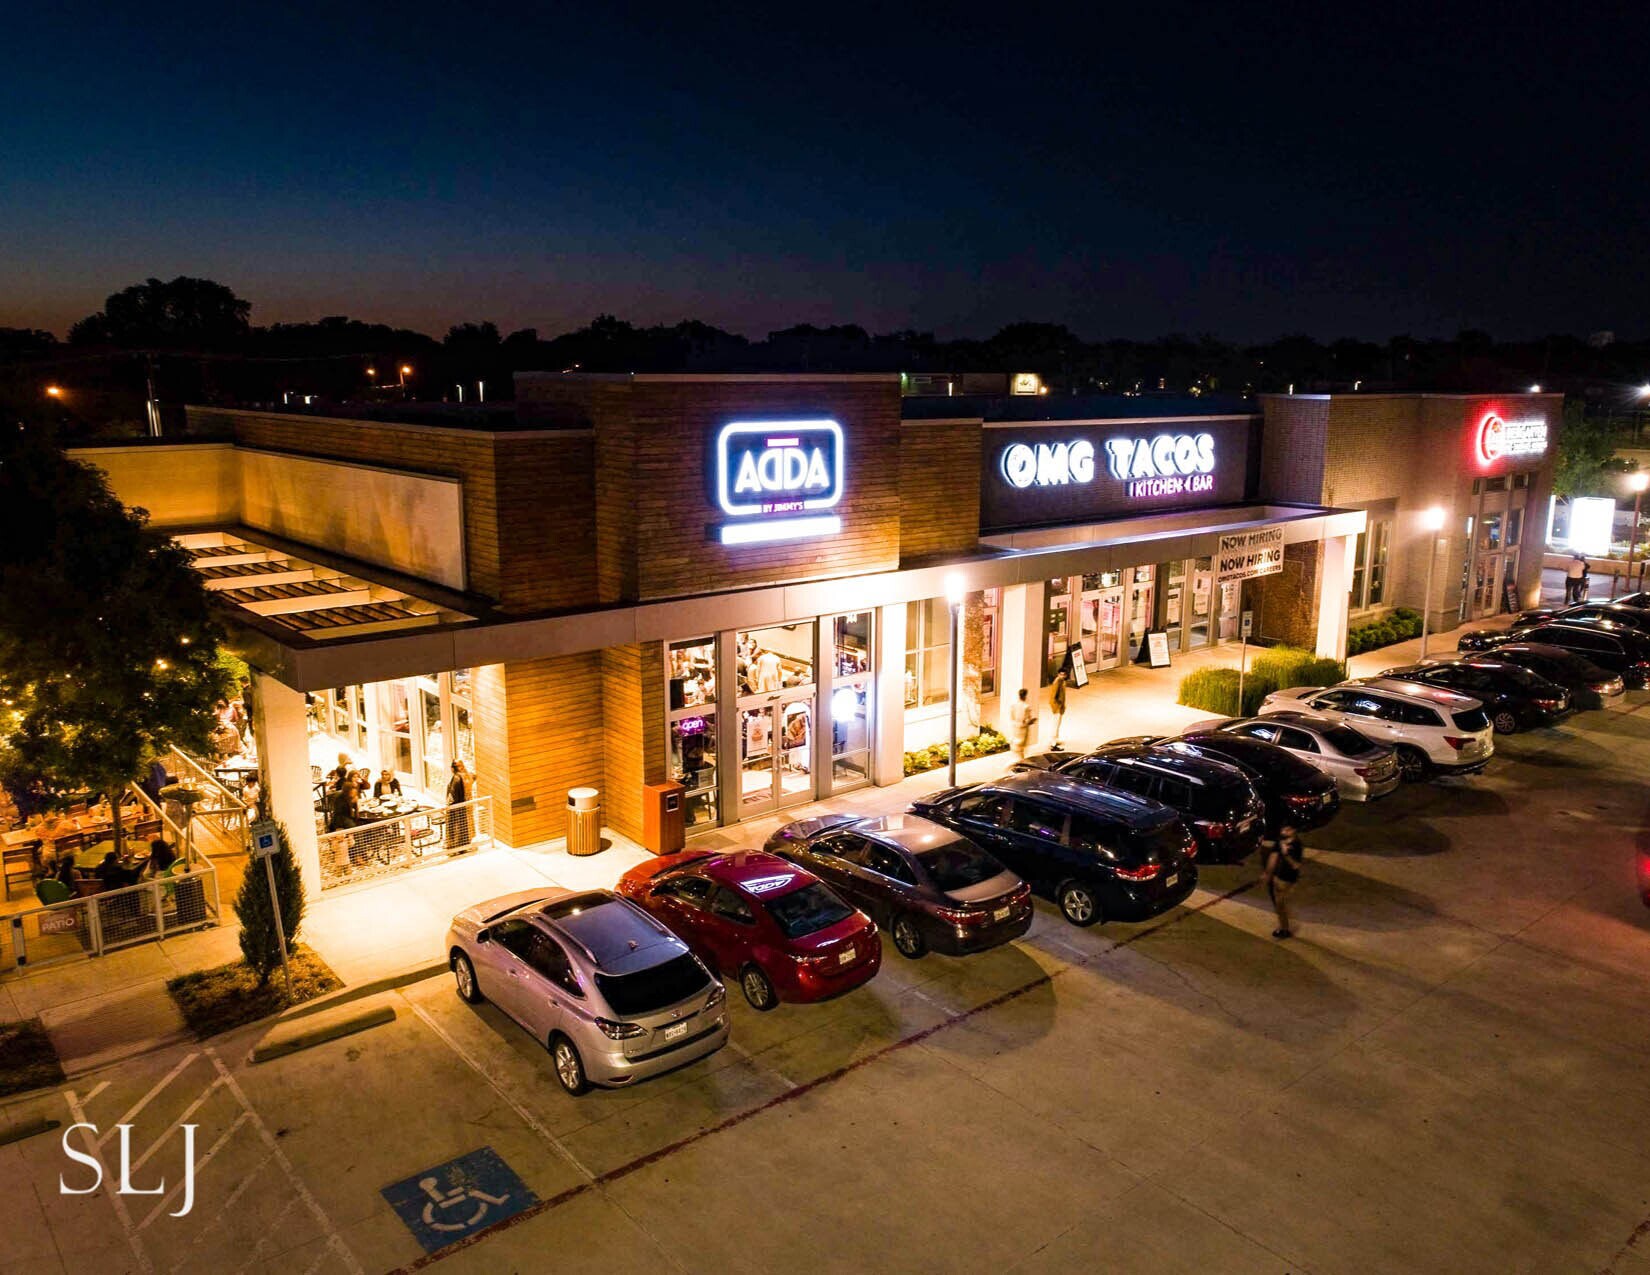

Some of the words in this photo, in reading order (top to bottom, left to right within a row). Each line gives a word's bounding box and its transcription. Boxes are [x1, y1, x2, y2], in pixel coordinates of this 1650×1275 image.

[735, 447, 830, 493] ADDA
[1003, 440, 1095, 488] OMG
[1107, 434, 1215, 480] TACOS
[1135, 478, 1183, 497] KITCHEN
[1193, 475, 1213, 491] BAR
[1221, 535, 1246, 551] NOW
[1248, 528, 1282, 545] HIRING
[1220, 556, 1245, 572] NOW
[1247, 550, 1281, 567] HIRING
[42, 918, 74, 932] PATIO
